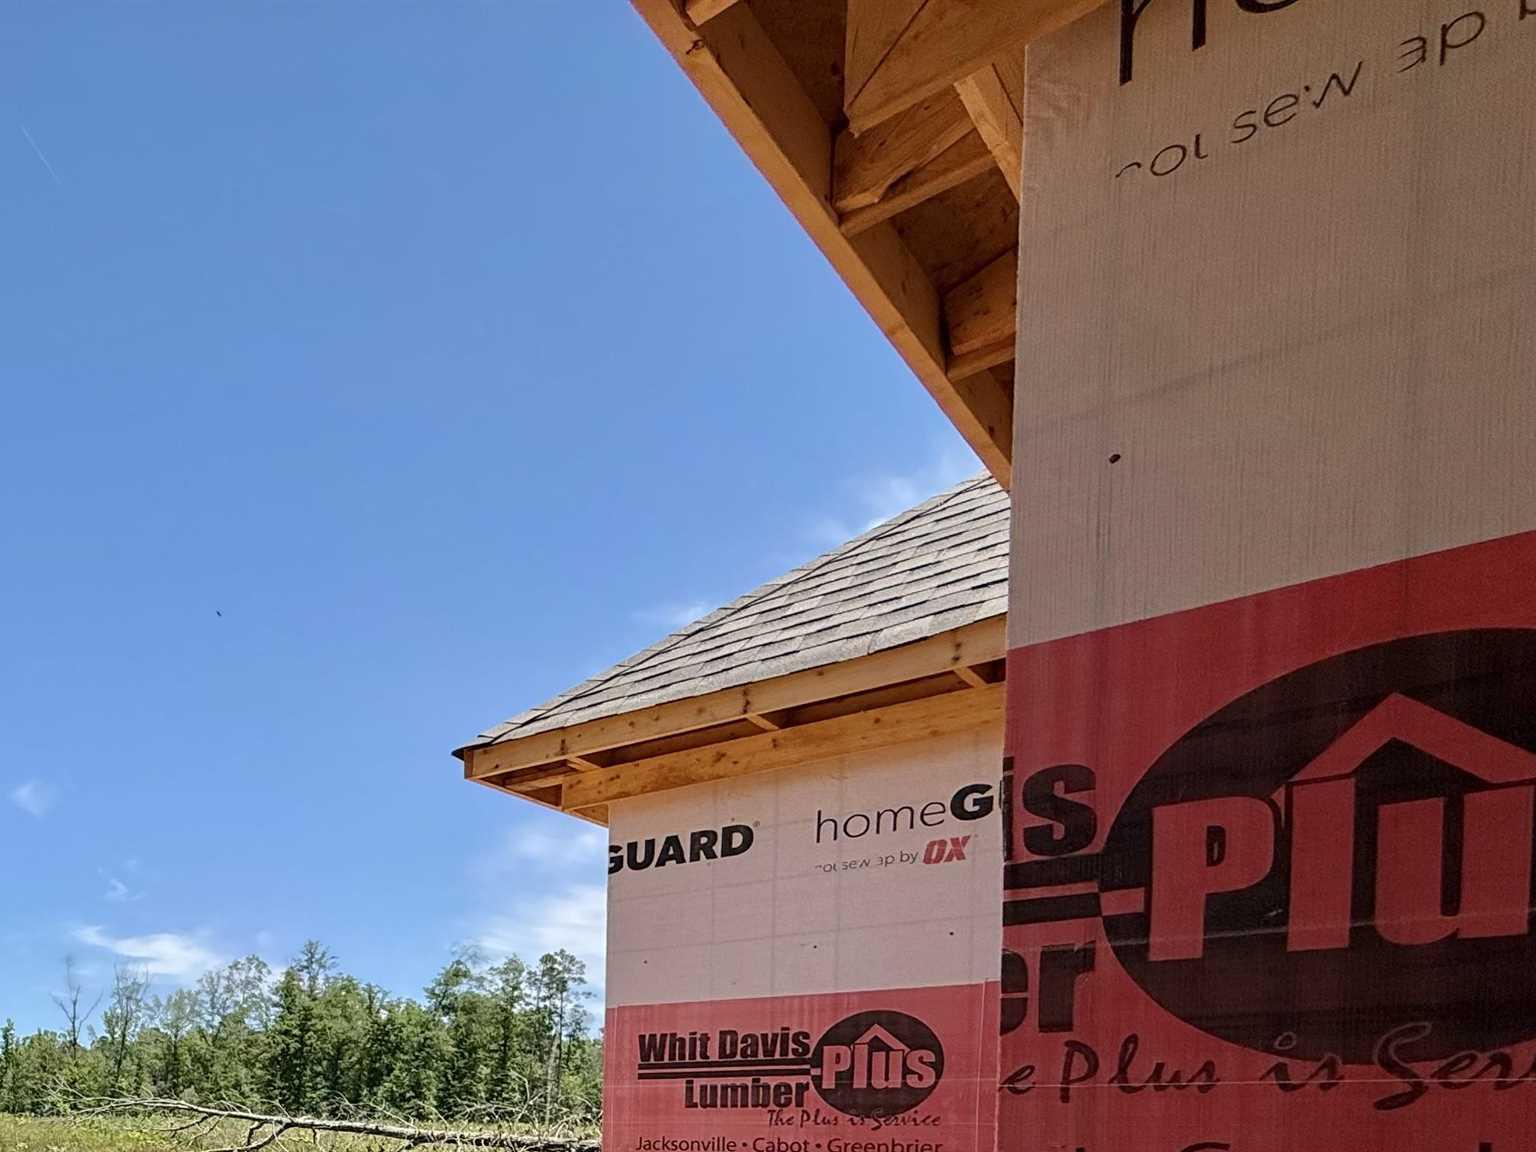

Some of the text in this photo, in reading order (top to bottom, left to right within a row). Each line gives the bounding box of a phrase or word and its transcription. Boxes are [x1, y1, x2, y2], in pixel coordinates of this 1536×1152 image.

[816, 783, 1004, 843] homeG
[900, 850, 919, 865] by
[922, 835, 971, 865] OX
[637, 1027, 811, 1063] Whit Davis
[821, 1041, 936, 1090] Plus
[1060, 1033, 1221, 1104] Plus
[684, 1078, 810, 1109] Lumber
[767, 1109, 794, 1127] The
[800, 1108, 839, 1129] Plus
[870, 1109, 942, 1131] Service
[635, 1136, 737, 1152] Jacksonville
